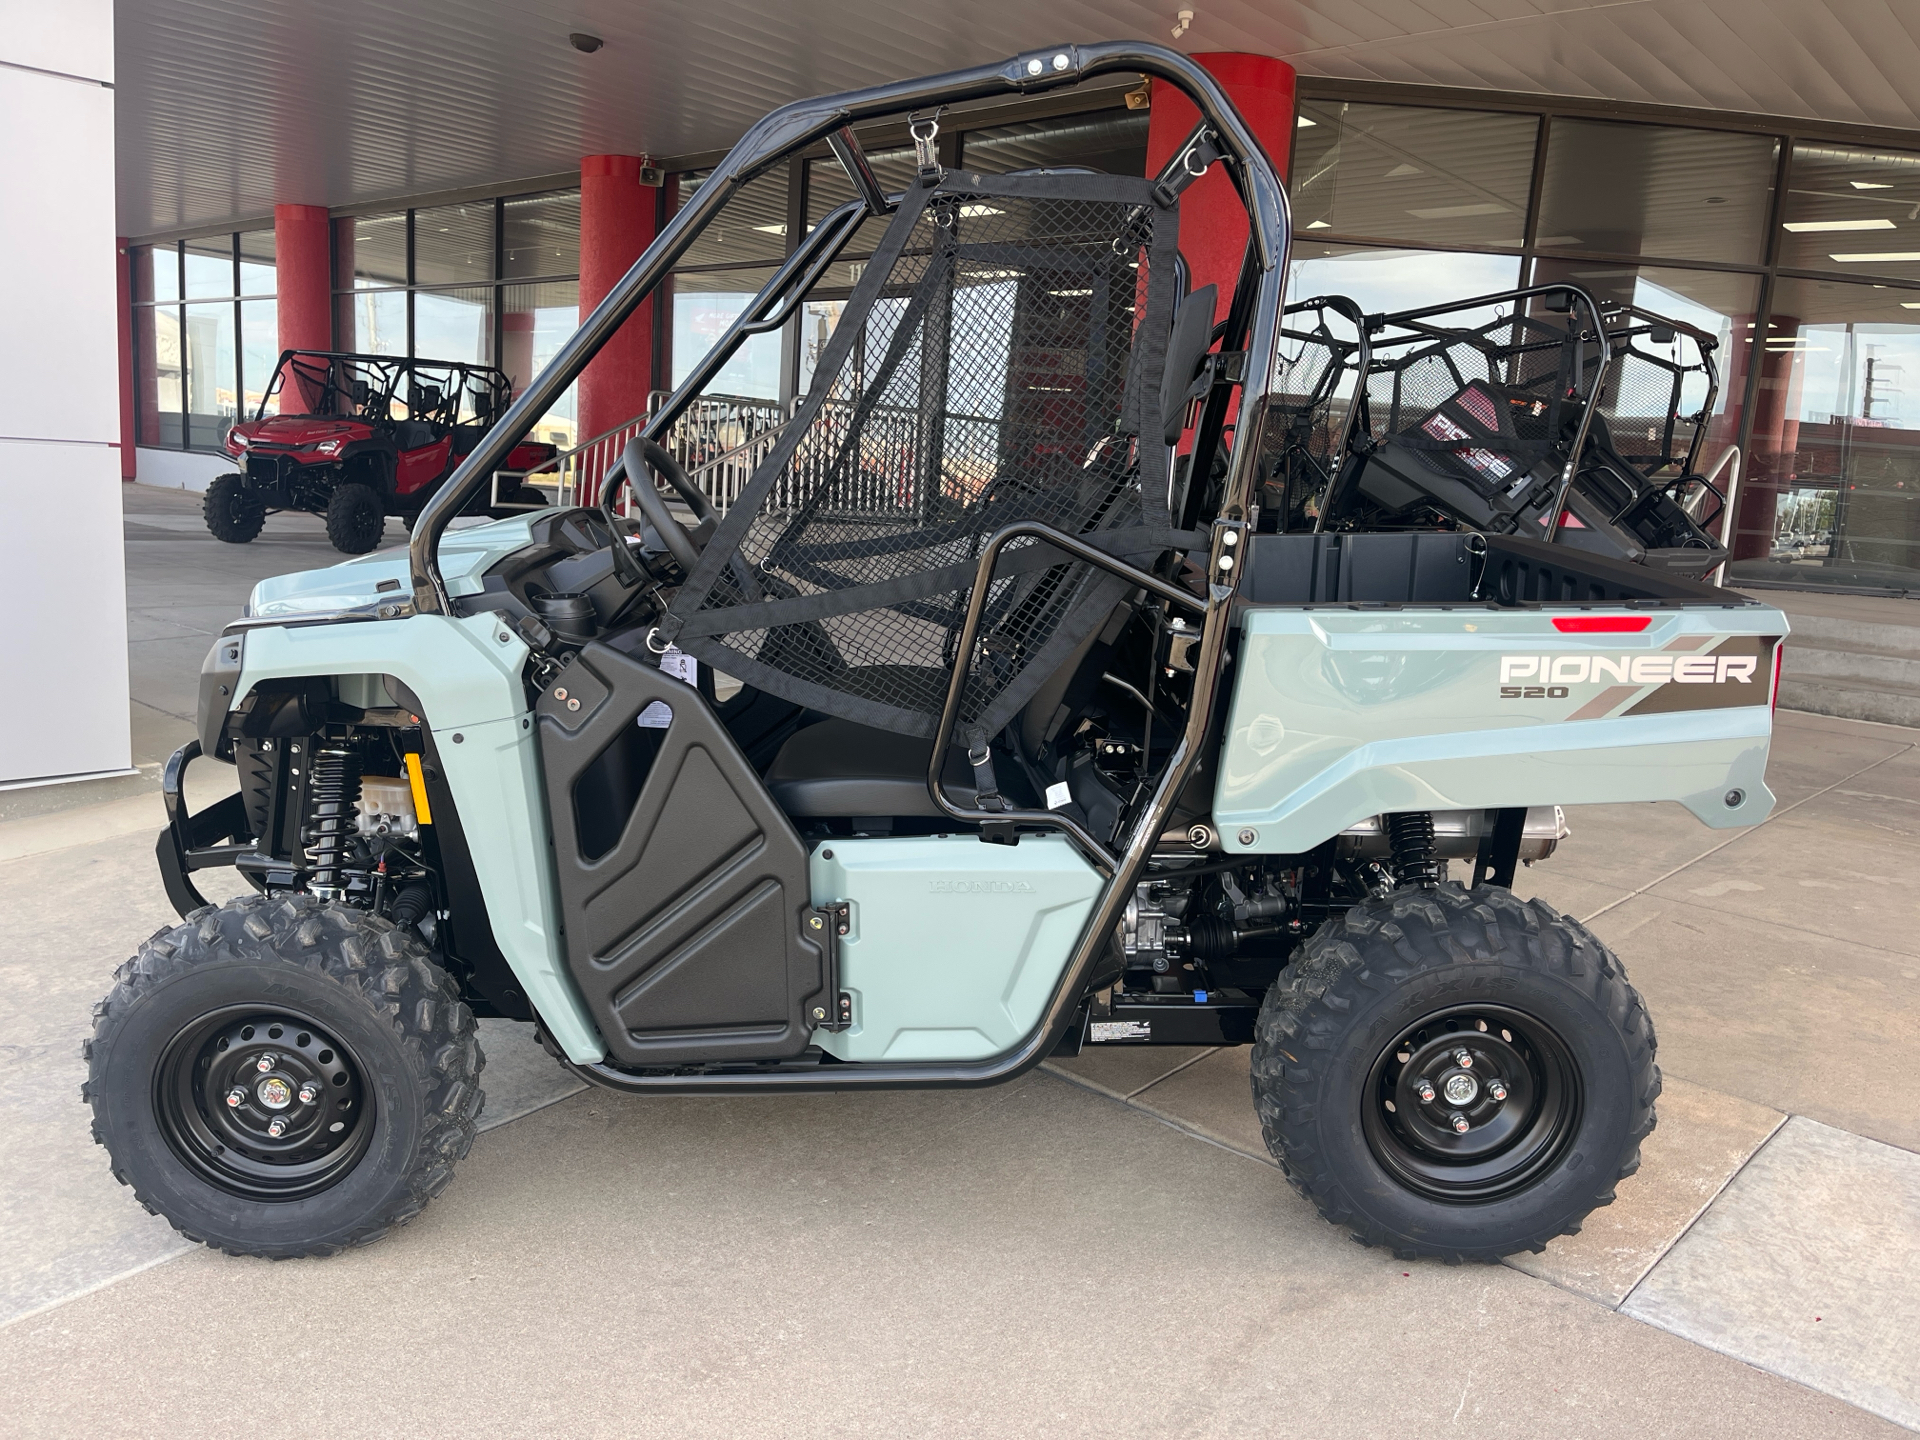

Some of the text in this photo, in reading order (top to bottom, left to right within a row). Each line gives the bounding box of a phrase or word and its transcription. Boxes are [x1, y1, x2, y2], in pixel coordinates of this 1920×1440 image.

[1499, 655, 1758, 684] PIONEER
[1500, 686, 1569, 699] 520
[929, 880, 1037, 894] HONDA
[1342, 976, 1520, 1077] MAXXIS
[262, 983, 402, 1111] MAXXIS
